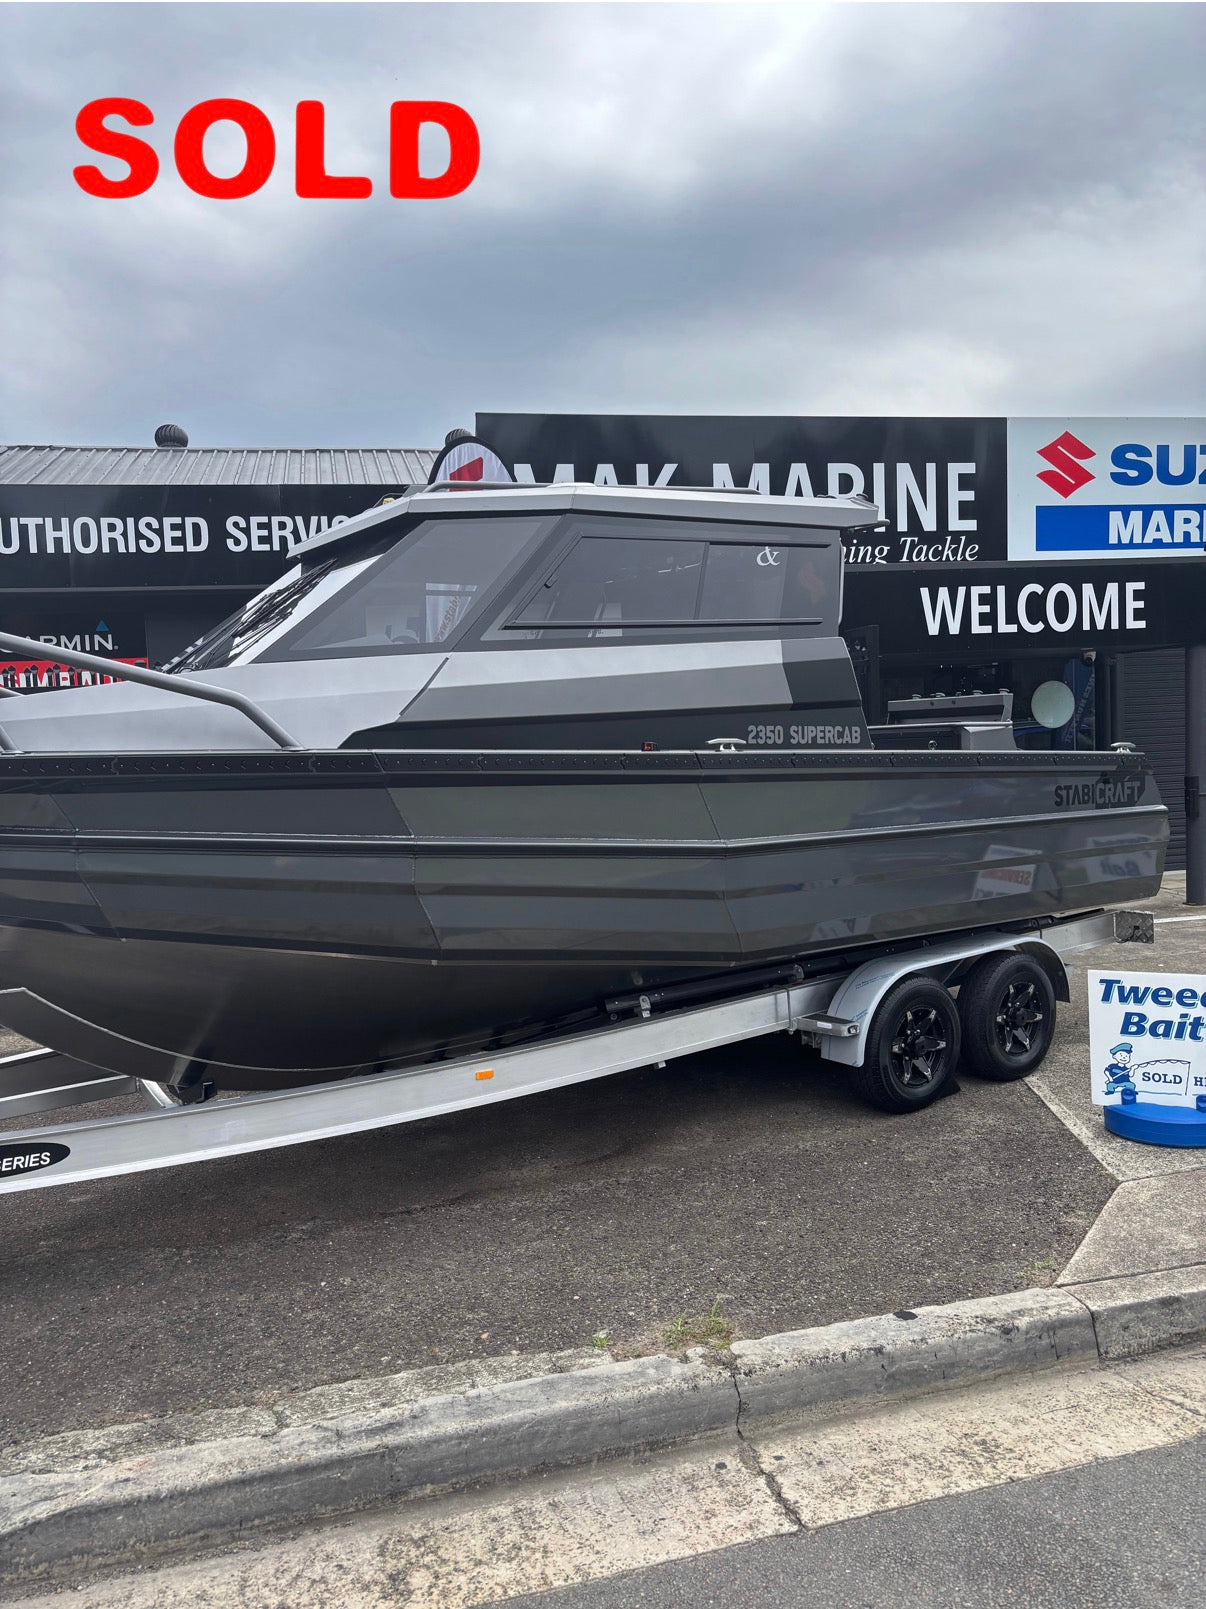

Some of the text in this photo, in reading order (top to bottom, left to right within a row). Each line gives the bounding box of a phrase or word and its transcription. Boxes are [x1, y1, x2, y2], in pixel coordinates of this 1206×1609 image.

[1110, 443, 1206, 486] SU
[0, 515, 351, 555] UTHORISED SERV
[756, 546, 781, 566] &
[899, 535, 979, 562] Tackle
[920, 581, 1146, 636] WELCOME
[747, 725, 861, 744] 2350 SUPERCAB
[1054, 780, 1141, 807] STABICRAFT
[1099, 978, 1206, 1008] Twee
[1141, 1071, 1183, 1085] SOLD
